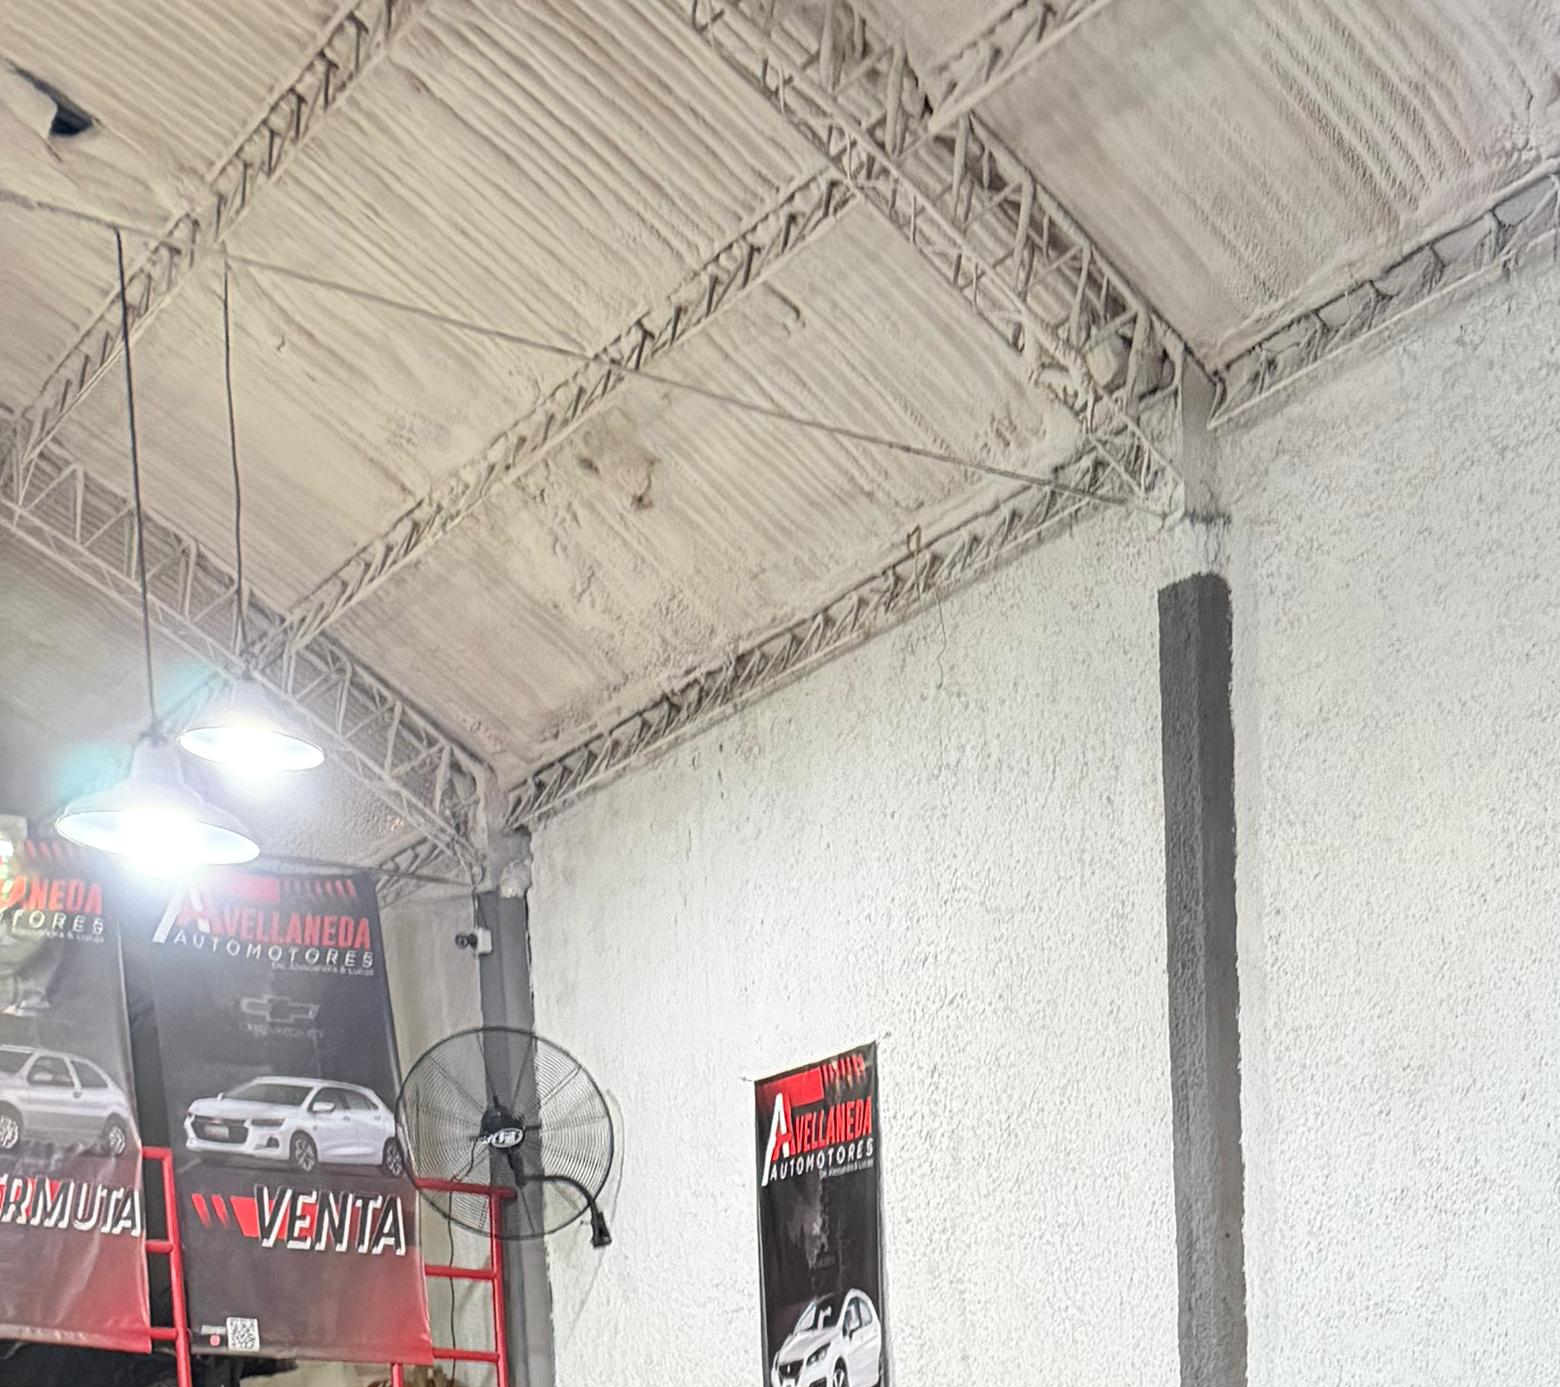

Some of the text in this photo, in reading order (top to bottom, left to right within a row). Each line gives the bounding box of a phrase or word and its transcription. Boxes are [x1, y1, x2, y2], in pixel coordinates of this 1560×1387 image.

[0, 908, 104, 935] TORES
[152, 882, 371, 950] AVELLANEDA
[173, 928, 374, 969] AUTOMOTORES
[761, 1093, 872, 1187] AVELLANEDA
[770, 1137, 874, 1181] AUTOMOTORES
[253, 1184, 406, 1256] VENTA
